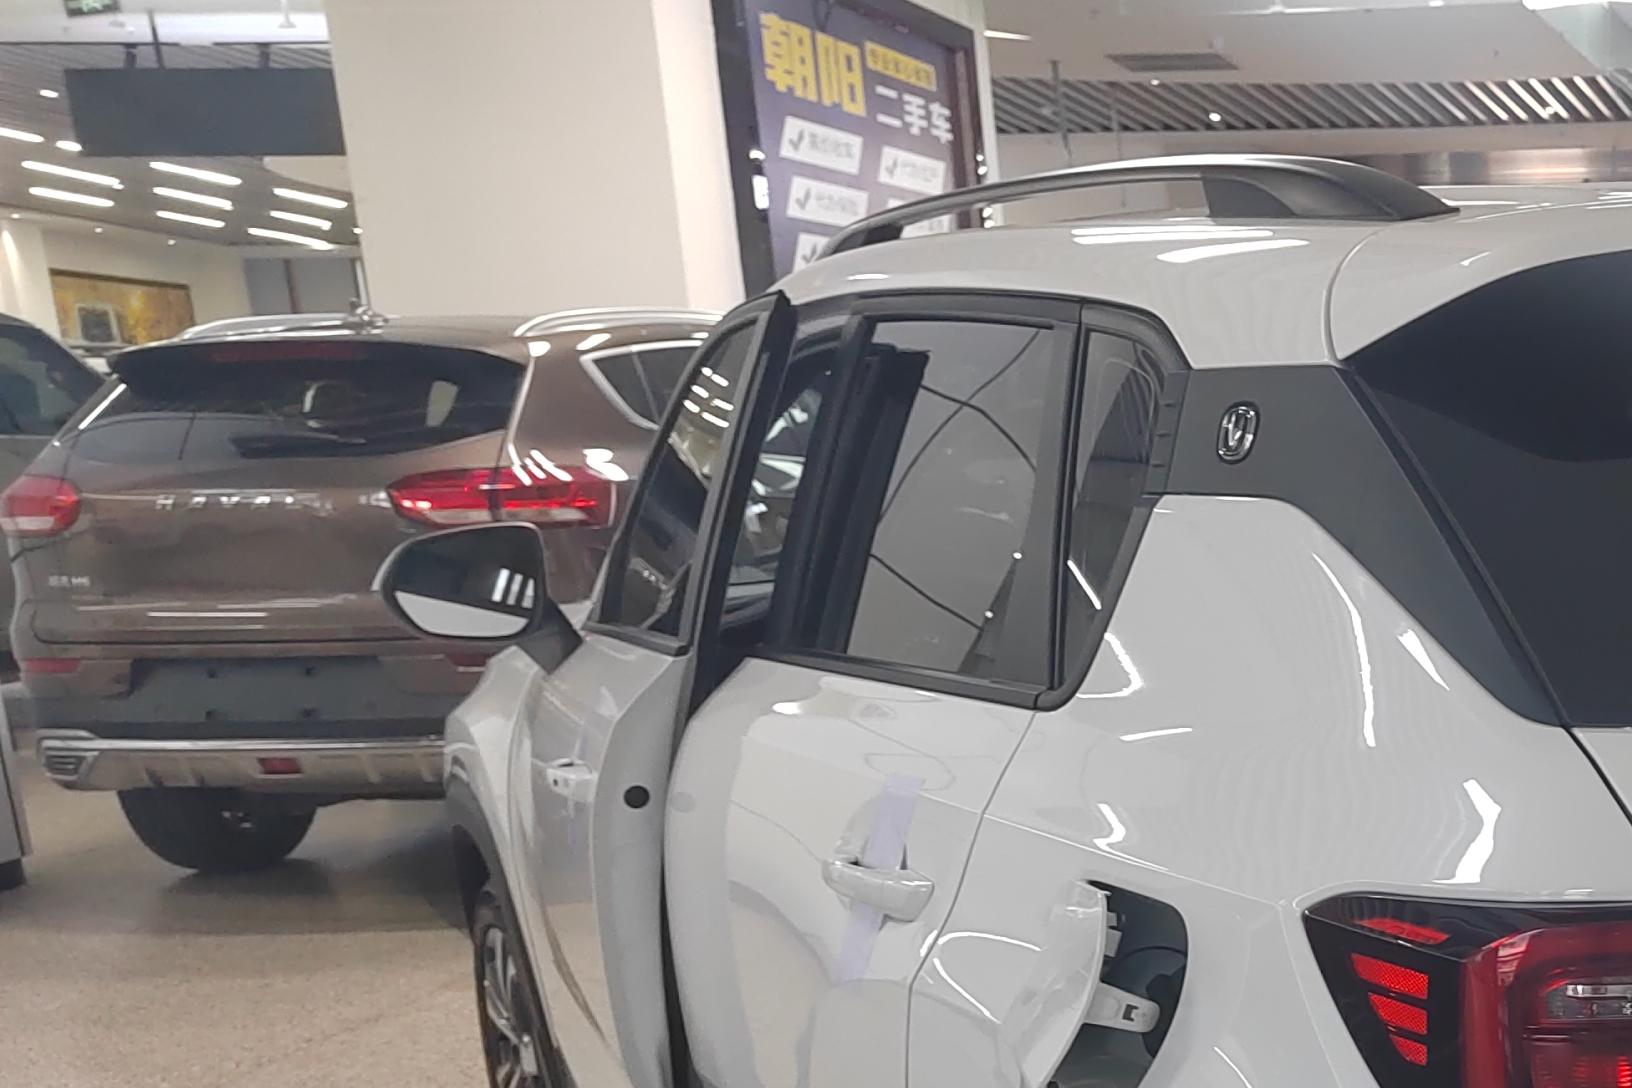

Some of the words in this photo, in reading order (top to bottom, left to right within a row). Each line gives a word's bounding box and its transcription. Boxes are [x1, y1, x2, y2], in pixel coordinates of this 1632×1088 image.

[759, 13, 867, 117] 朝阳
[875, 84, 954, 145] 二手车
